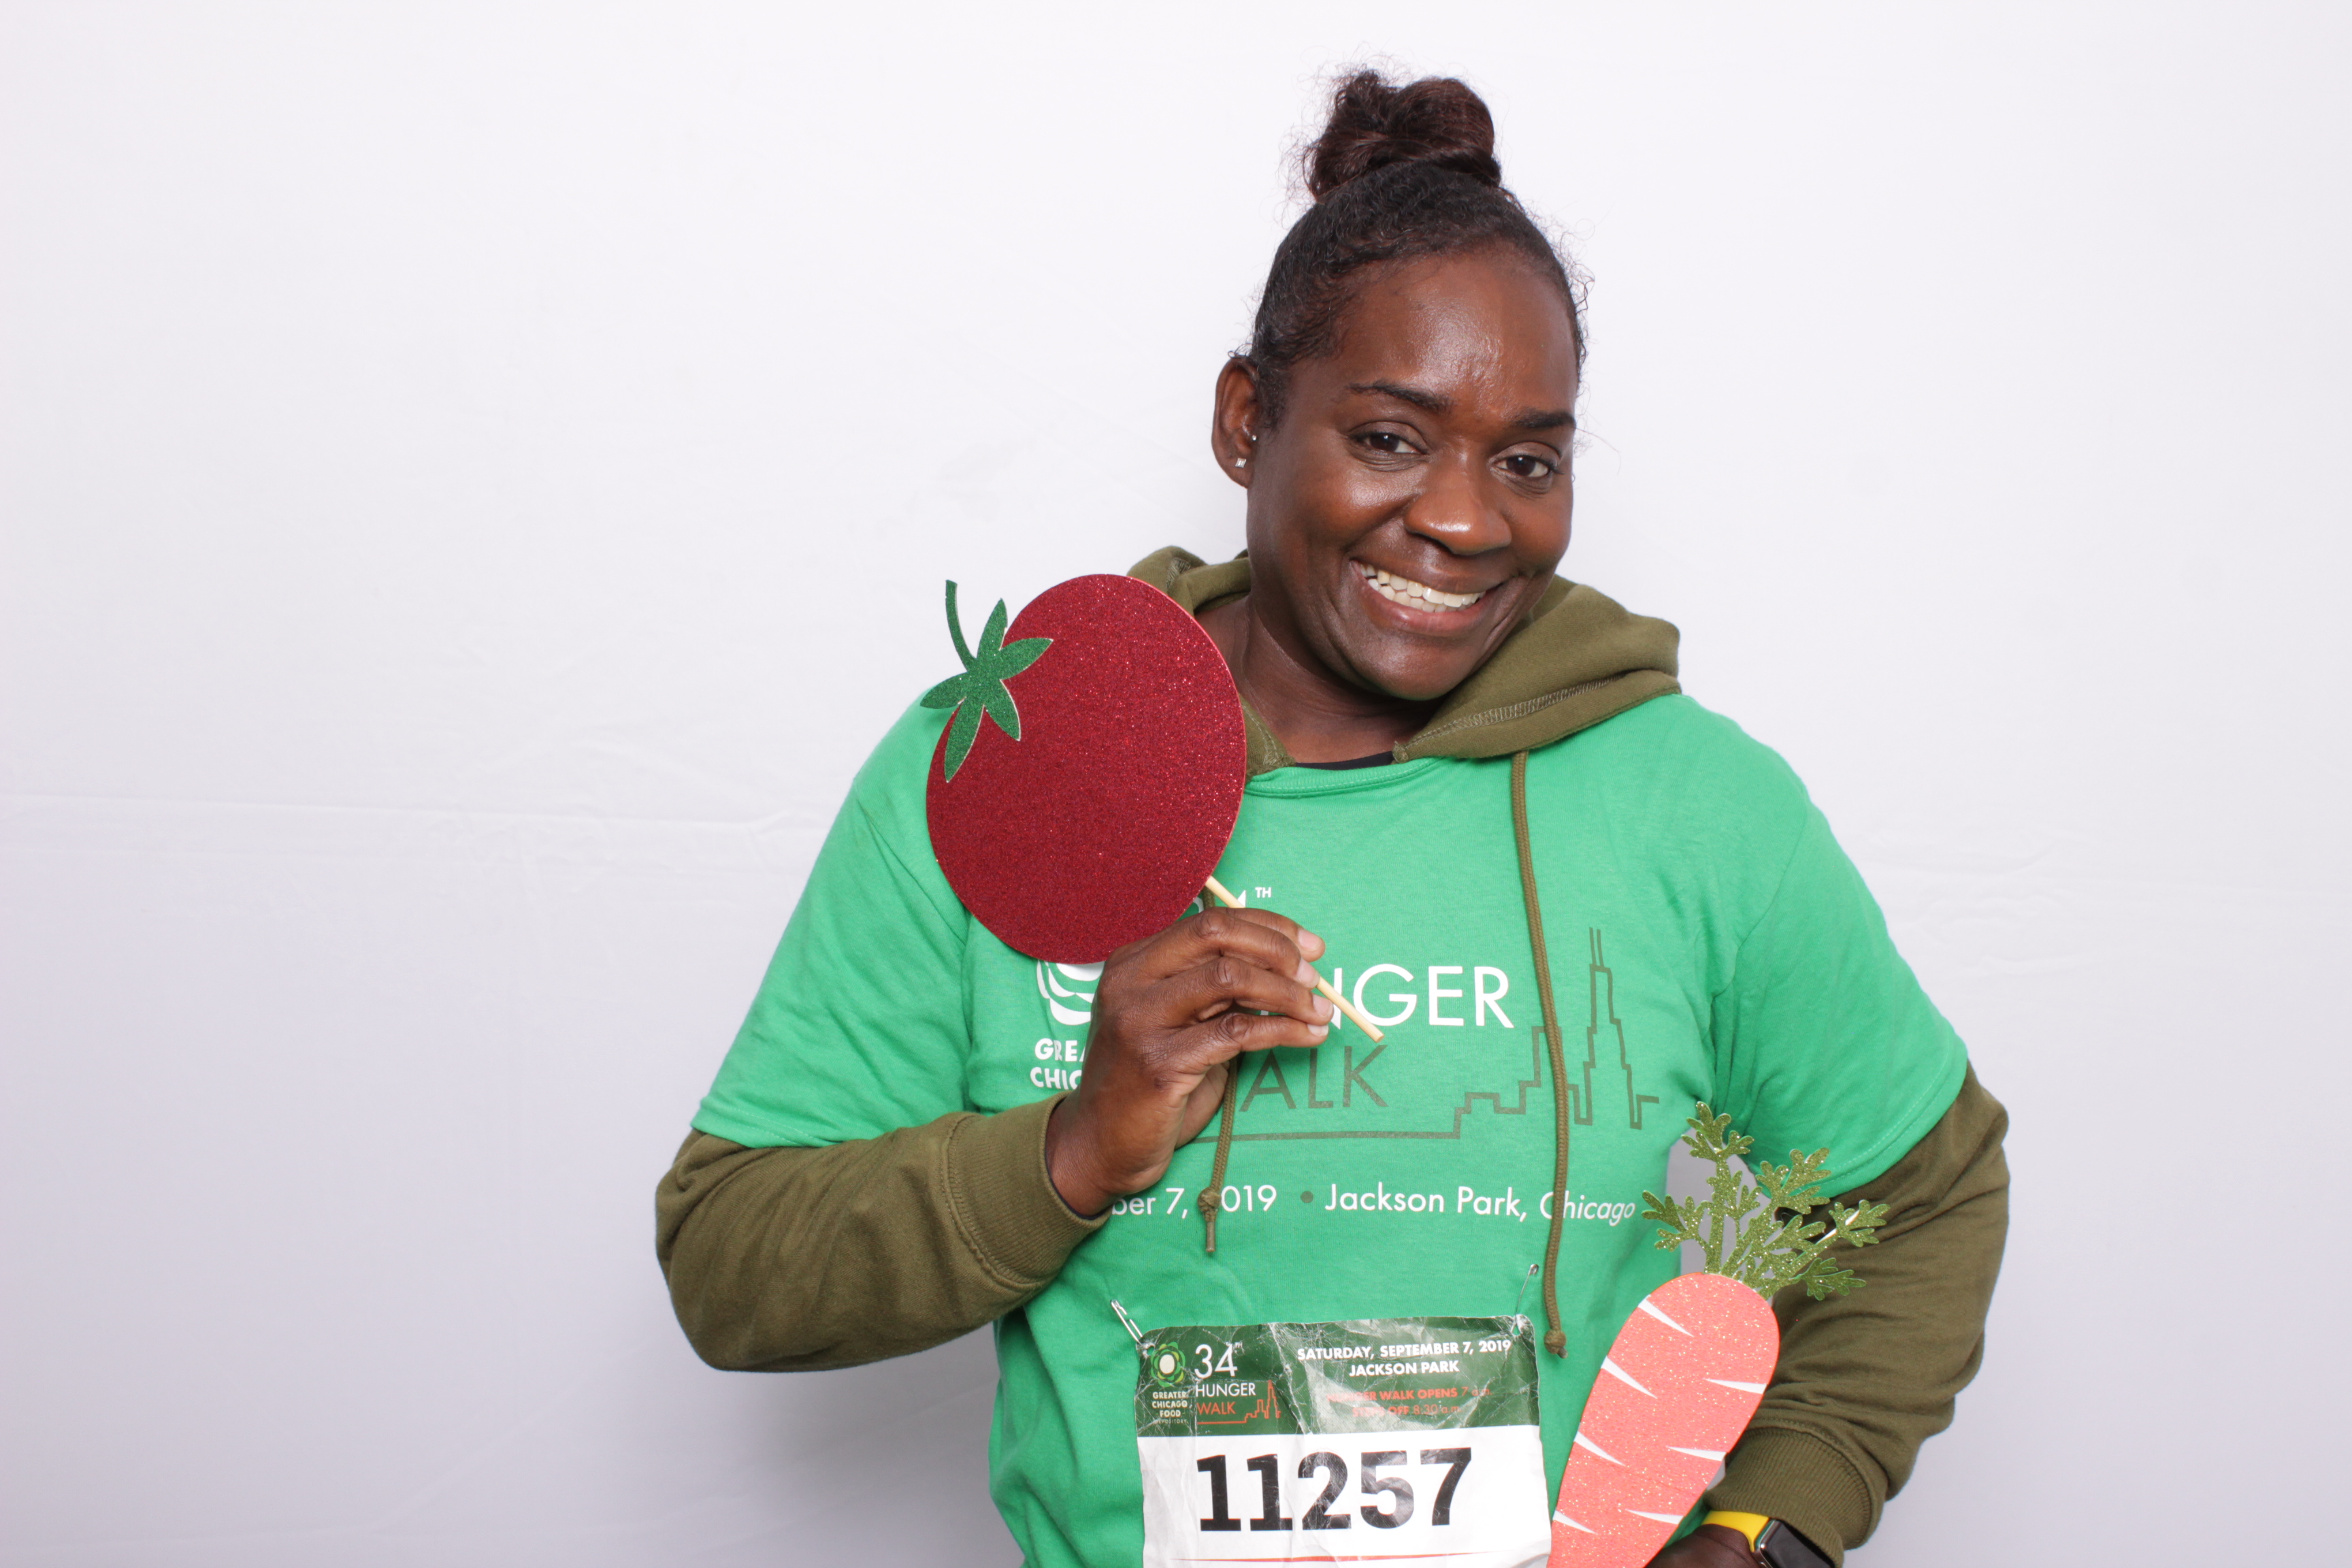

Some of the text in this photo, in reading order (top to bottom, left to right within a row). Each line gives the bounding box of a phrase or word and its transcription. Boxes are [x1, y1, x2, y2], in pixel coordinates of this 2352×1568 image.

[1239, 1044, 1389, 1112] ALK
[1166, 1188, 1188, 1220] 7,
[1220, 1184, 1277, 1212] 019
[1324, 1181, 1445, 1213] Jackson
[1457, 1186, 1528, 1222] Park,
[1539, 1190, 1636, 1227] Chicago
[1297, 1339, 1512, 1361] SATURDAY, SEPTEMBER 7, 2019
[1349, 1360, 1460, 1377] JACKSON PARK
[1152, 1392, 1189, 1400] GREATER
[1194, 1382, 1256, 1398] HUNGER
[1379, 1390, 1415, 1401] WALK
[1417, 1387, 1458, 1399] OPENS
[1461, 1386, 1469, 1396] 7
[1152, 1401, 1188, 1409] CHICAGO
[1196, 1402, 1236, 1415] WALK
[1388, 1405, 1410, 1416] OFF
[1413, 1403, 1439, 1415] 8:30
[1159, 1409, 1181, 1418] FOOD
[1196, 1447, 1471, 1531] 11257
